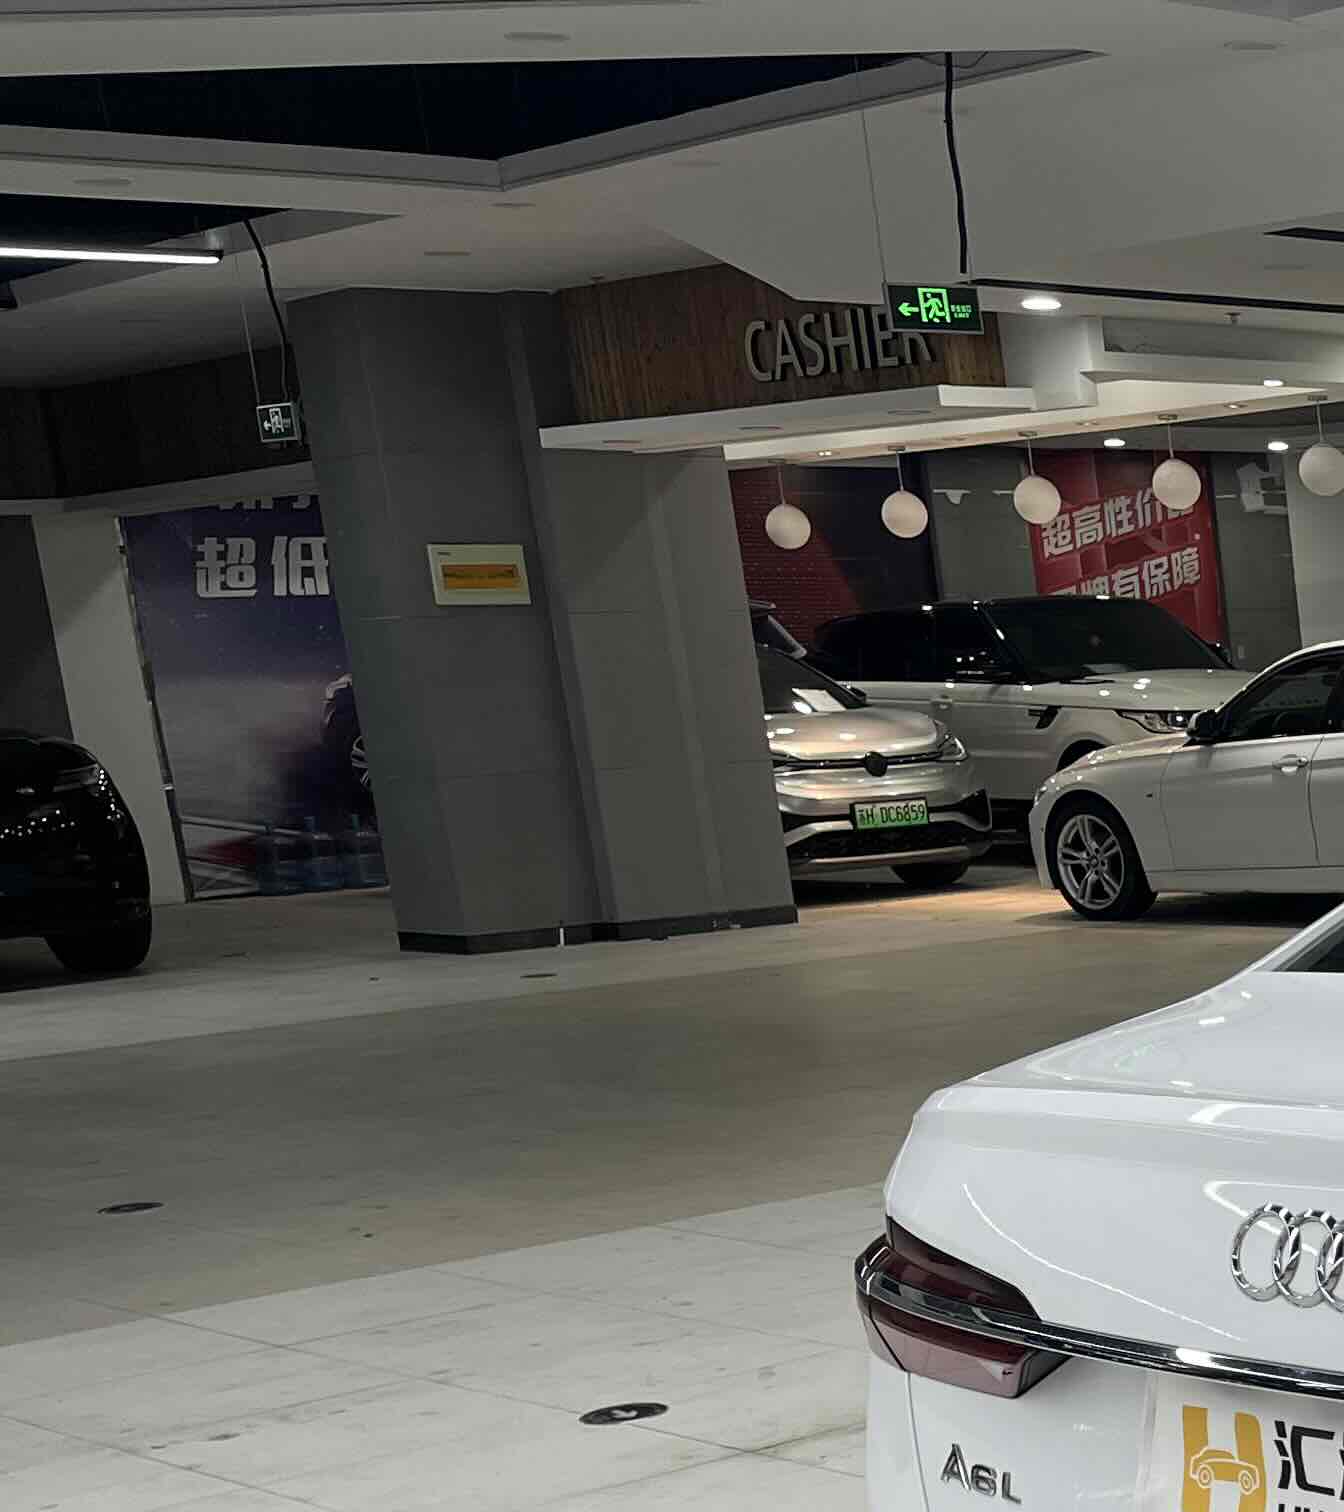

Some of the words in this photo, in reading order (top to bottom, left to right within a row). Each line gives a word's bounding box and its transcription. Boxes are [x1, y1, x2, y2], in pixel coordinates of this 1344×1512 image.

[1041, 487, 1194, 559] 超高性价
[1049, 547, 1201, 600] 有保障
[940, 1443, 1022, 1504] A6L
